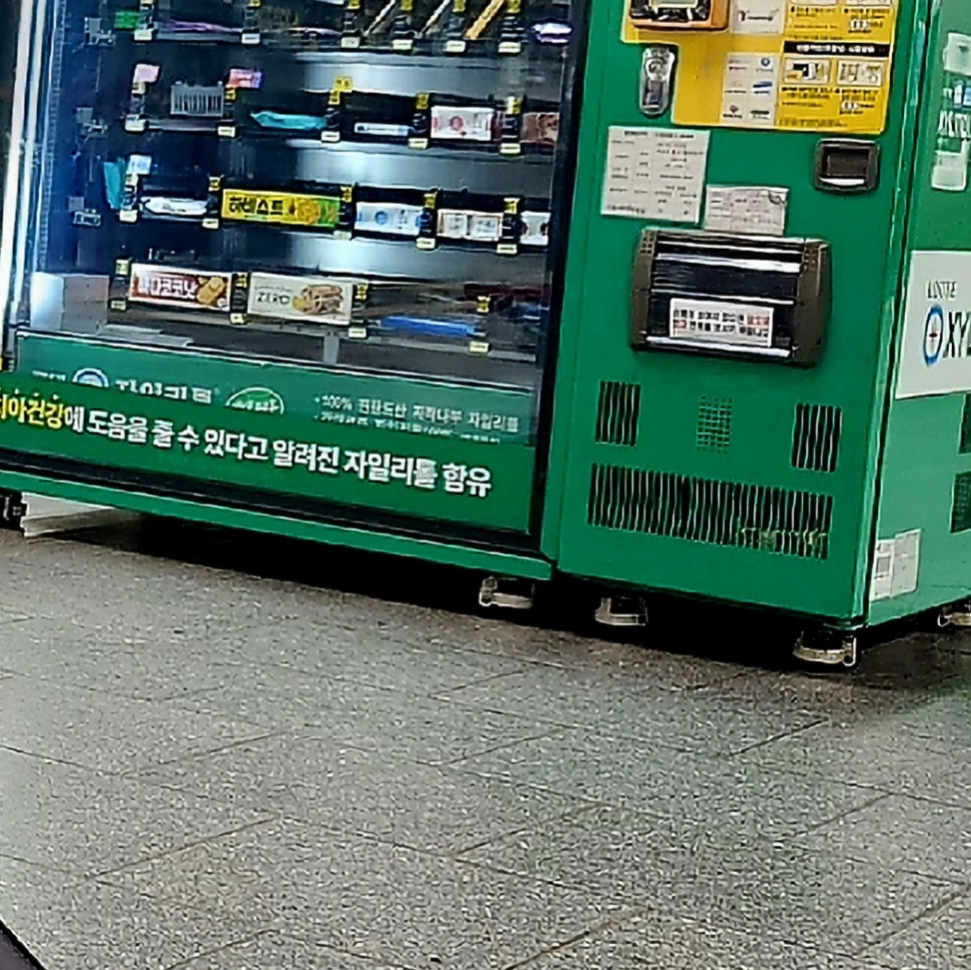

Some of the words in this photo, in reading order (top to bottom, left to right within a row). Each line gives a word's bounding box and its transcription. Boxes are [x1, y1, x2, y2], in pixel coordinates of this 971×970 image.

[151, 419, 175, 448] 줄
[177, 424, 200, 451] 수
[203, 428, 269, 460] 있다고
[272, 439, 340, 474] 알려진
[441, 462, 493, 498] 함유
